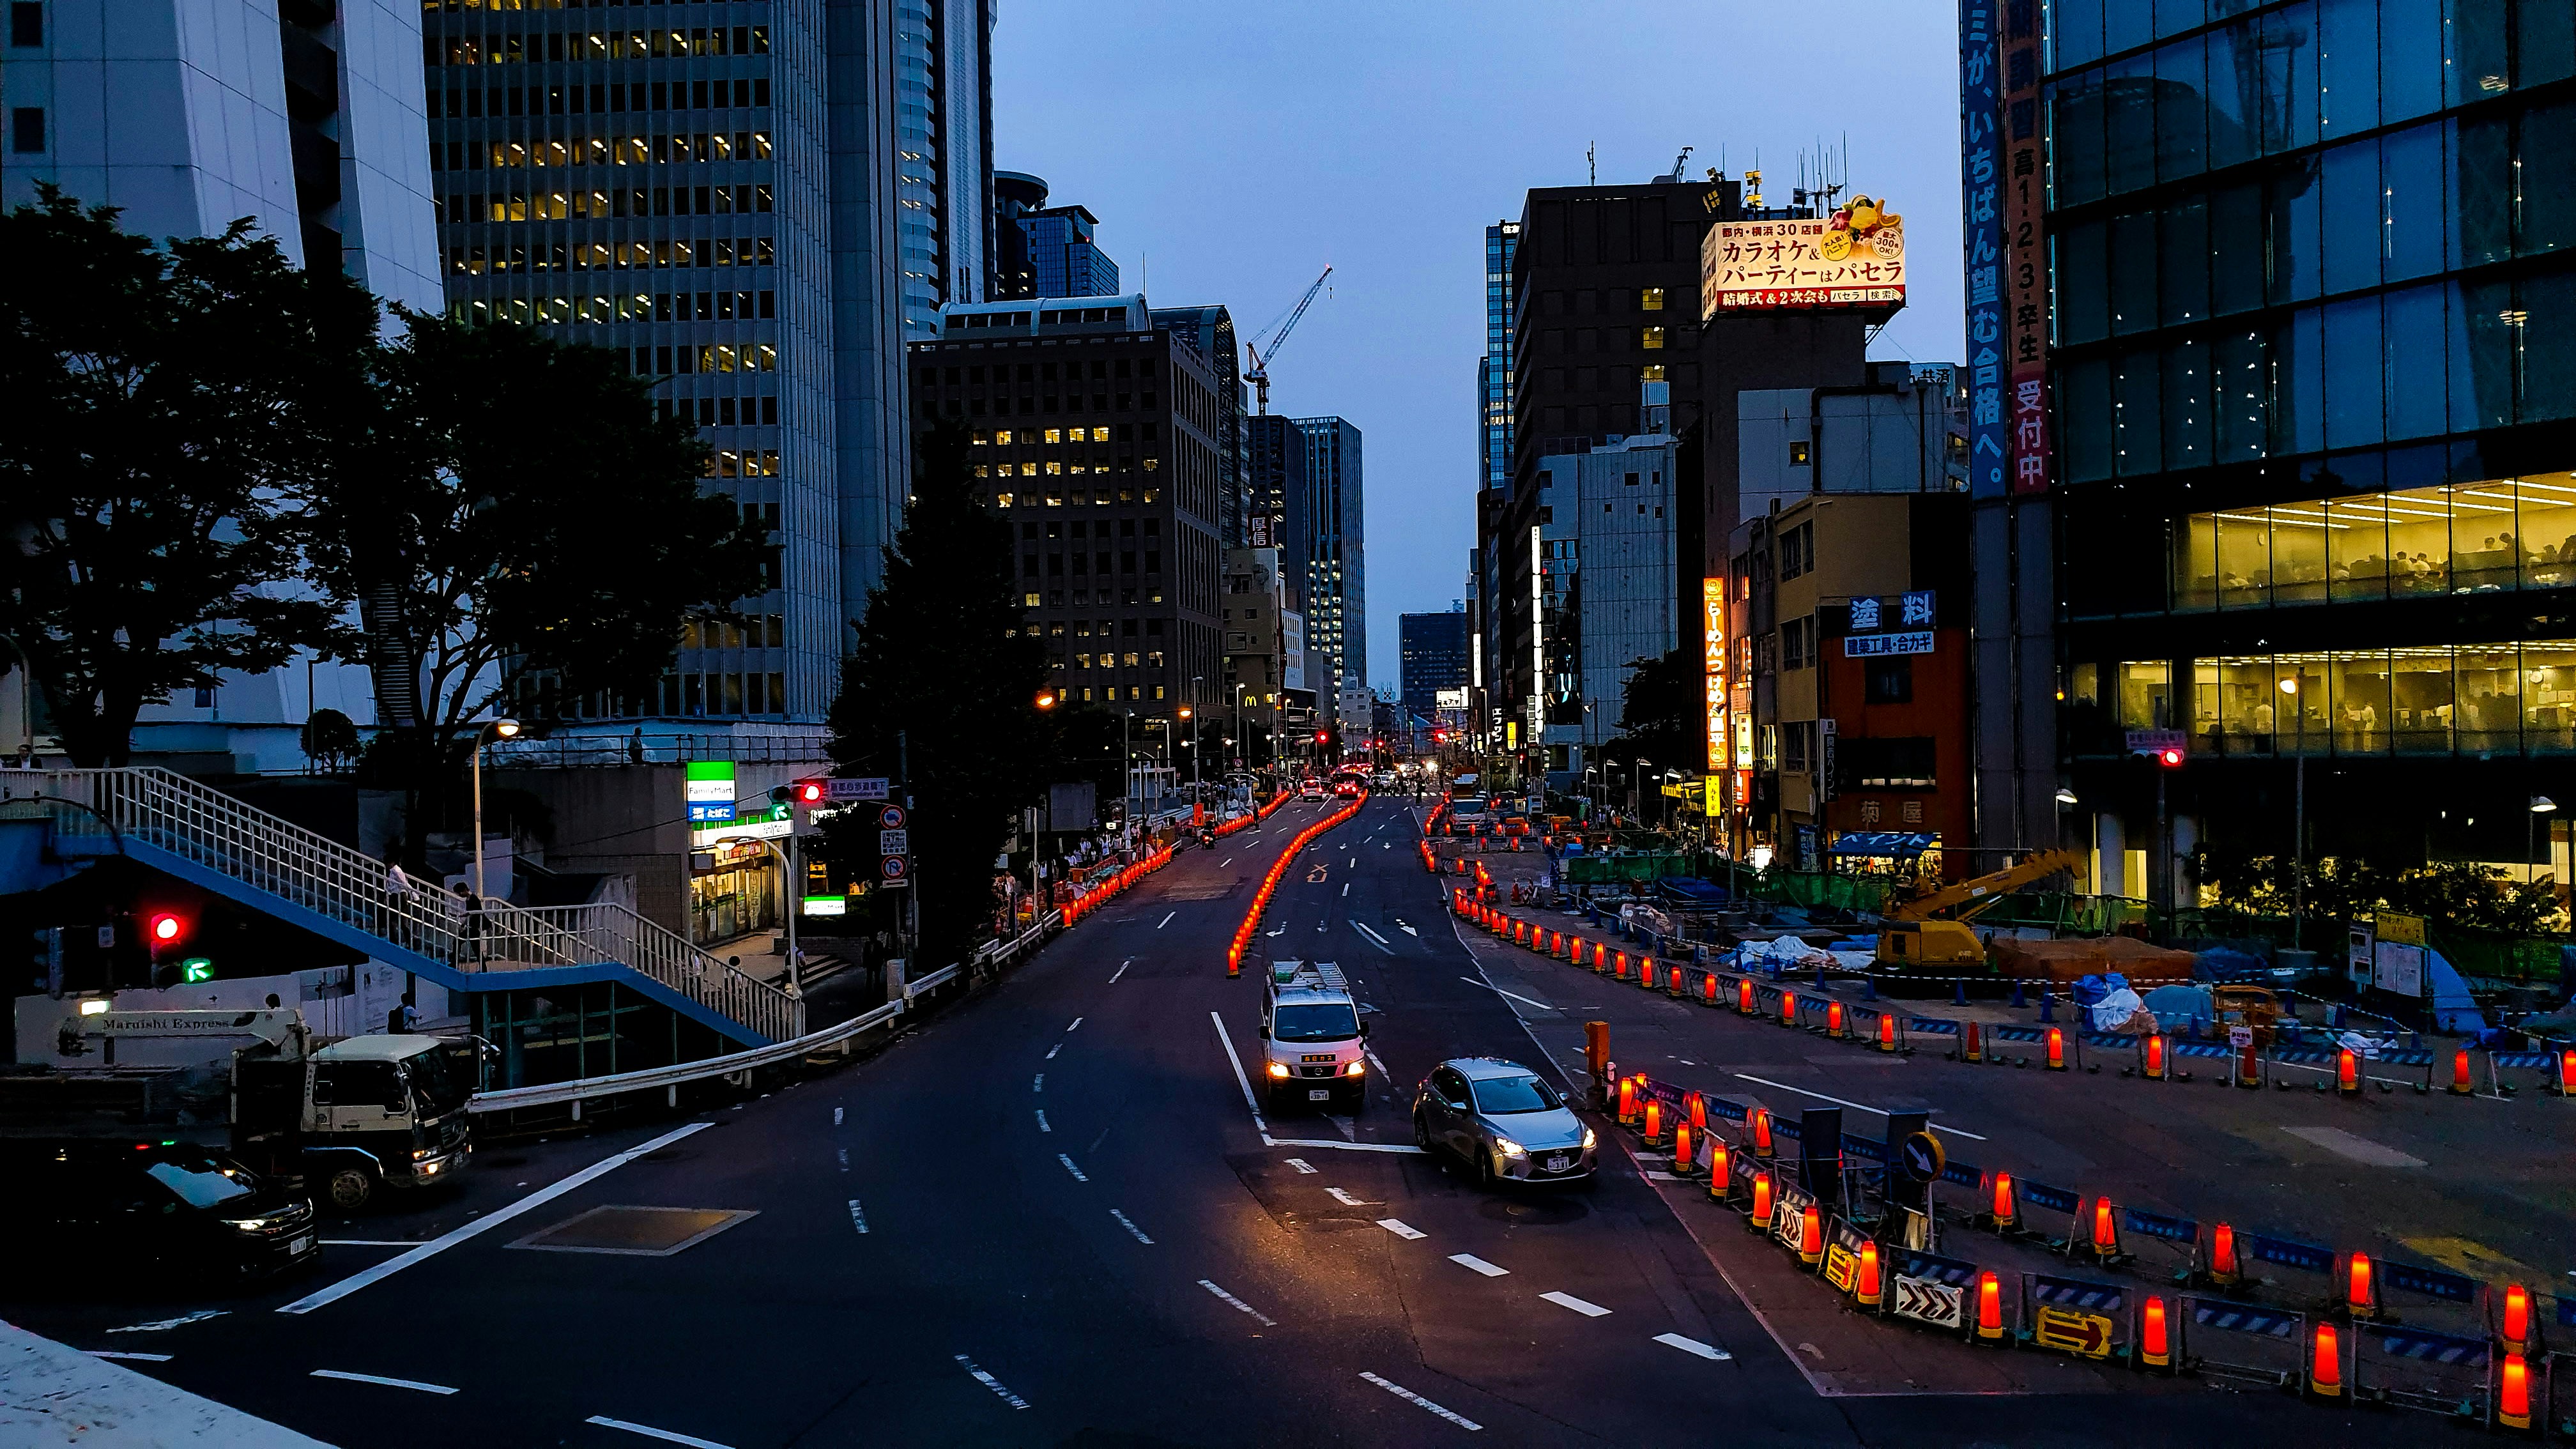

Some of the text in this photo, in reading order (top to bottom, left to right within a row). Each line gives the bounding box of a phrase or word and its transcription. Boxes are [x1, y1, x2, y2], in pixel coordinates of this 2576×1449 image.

[1826, 241, 1849, 256] ハニトー
[1967, 0, 2002, 483] ミが、いちばん望む合格へ。
[1723, 261, 1902, 285] パーティーはパセラ
[2016, 380, 2043, 486] 受付中
[1252, 518, 1267, 546] 厚信
[689, 787, 732, 795] FamilyMart
[707, 808, 731, 818] たばこ
[103, 1018, 229, 1029] Maruishi Express
